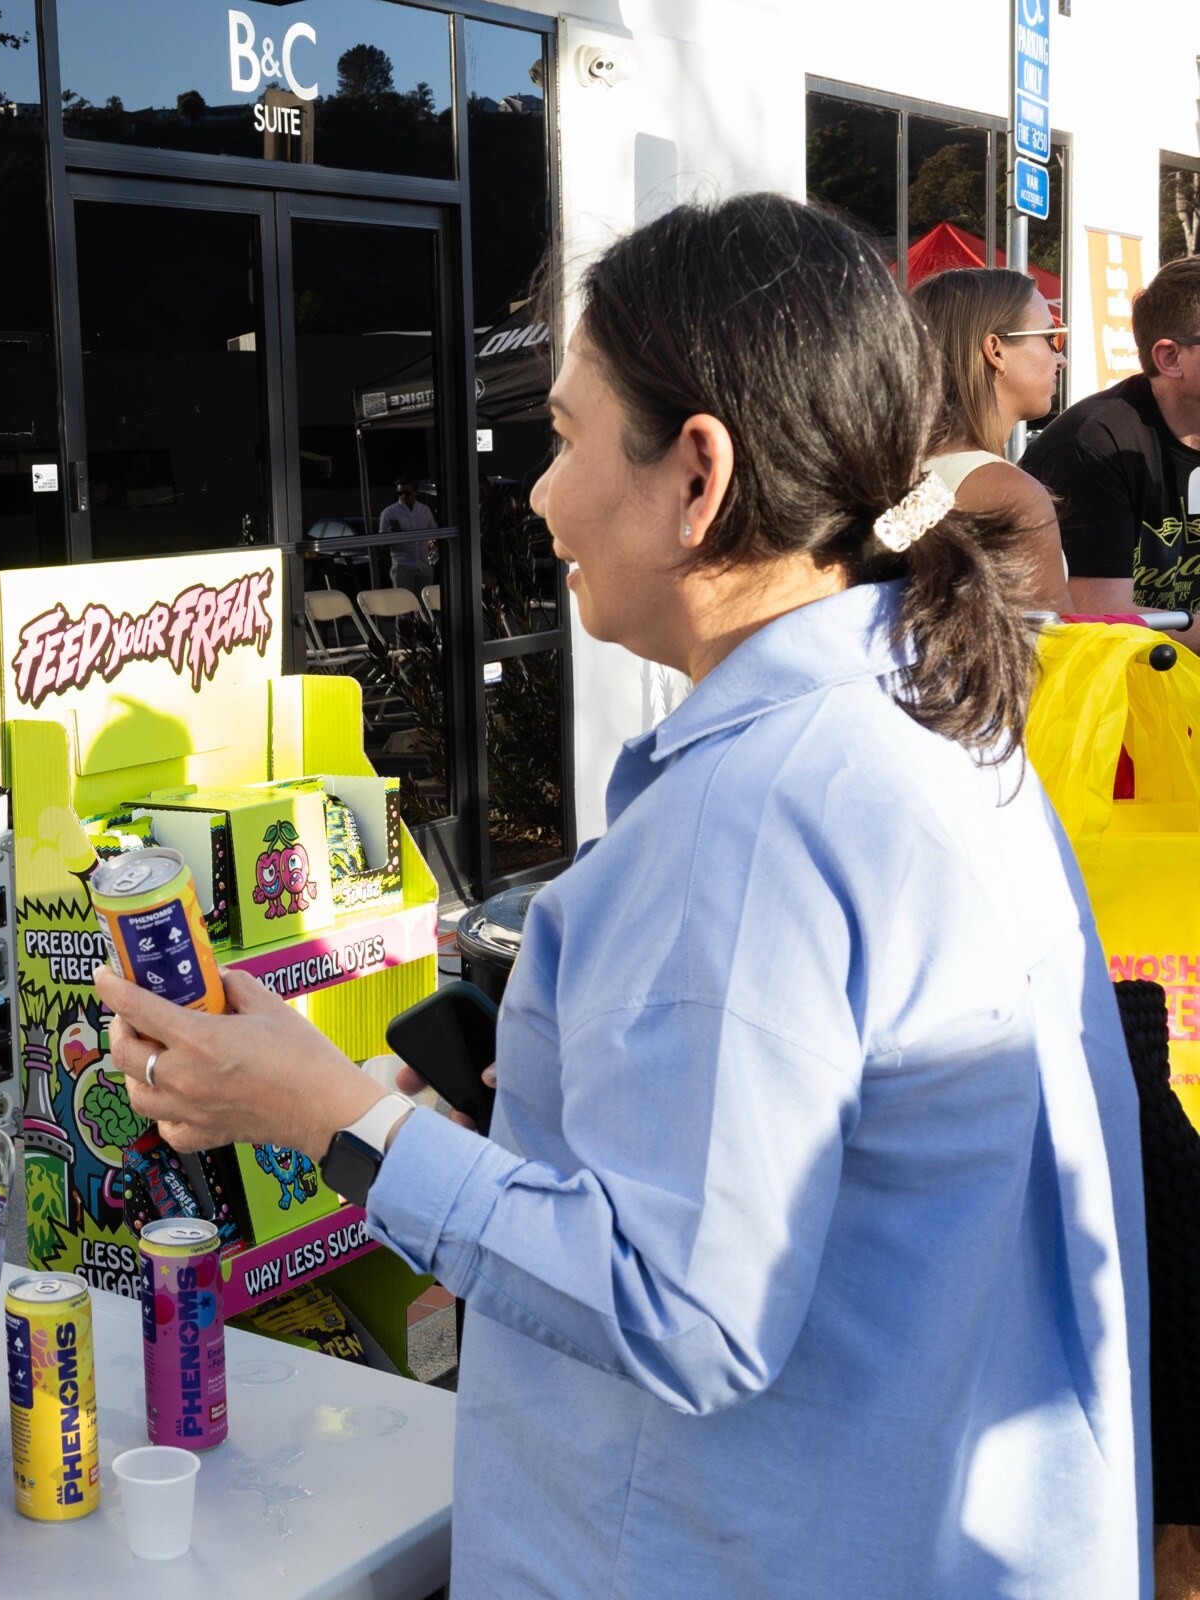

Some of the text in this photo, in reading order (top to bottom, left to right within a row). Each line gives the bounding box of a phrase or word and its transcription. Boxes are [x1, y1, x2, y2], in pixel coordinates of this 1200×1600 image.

[228, 9, 319, 101] B&C
[1018, 24, 1049, 66] PARKING
[1024, 60, 1043, 95] ONLY
[253, 103, 301, 136] SUITE
[1018, 122, 1048, 152] FINE $250
[1020, 190, 1044, 206] ACCESSIBLE
[1026, 173, 1039, 191] VAN
[13, 605, 111, 706] FEED
[167, 568, 273, 691] FREAK
[128, 907, 173, 926] PHENOMS
[135, 915, 172, 931] Super Blend
[25, 929, 105, 957] PREBIOT
[344, 934, 386, 972] DYES
[82, 1239, 136, 1273] LESS
[244, 1220, 376, 1298] WAY LESS SUGA
[177, 1266, 203, 1437] PHENOMS
[56, 1321, 84, 1506] PHENOMS
